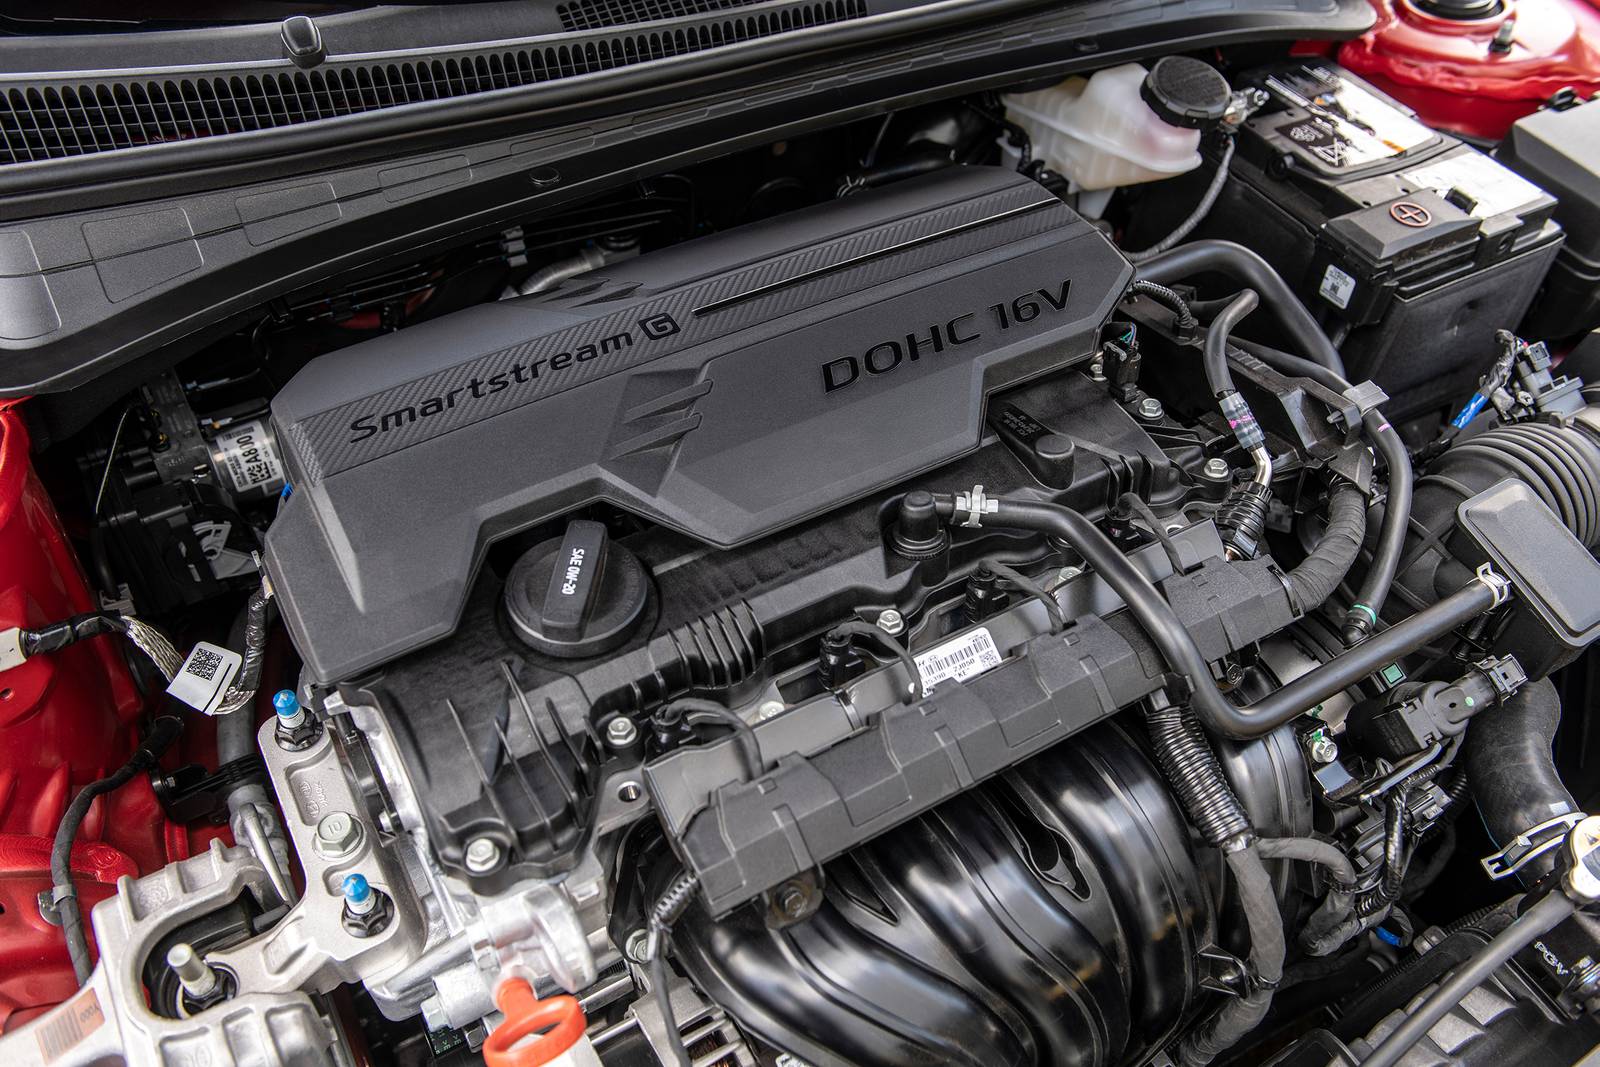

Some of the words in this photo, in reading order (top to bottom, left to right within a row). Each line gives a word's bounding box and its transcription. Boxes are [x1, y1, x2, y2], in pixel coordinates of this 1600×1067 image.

[822, 312, 981, 393] DOHC
[987, 279, 1072, 330] 16V
[350, 331, 633, 444] Smartstream
[236, 435, 262, 464] A800
[570, 548, 585, 566] SAE
[562, 566, 580, 595] 0W-20
